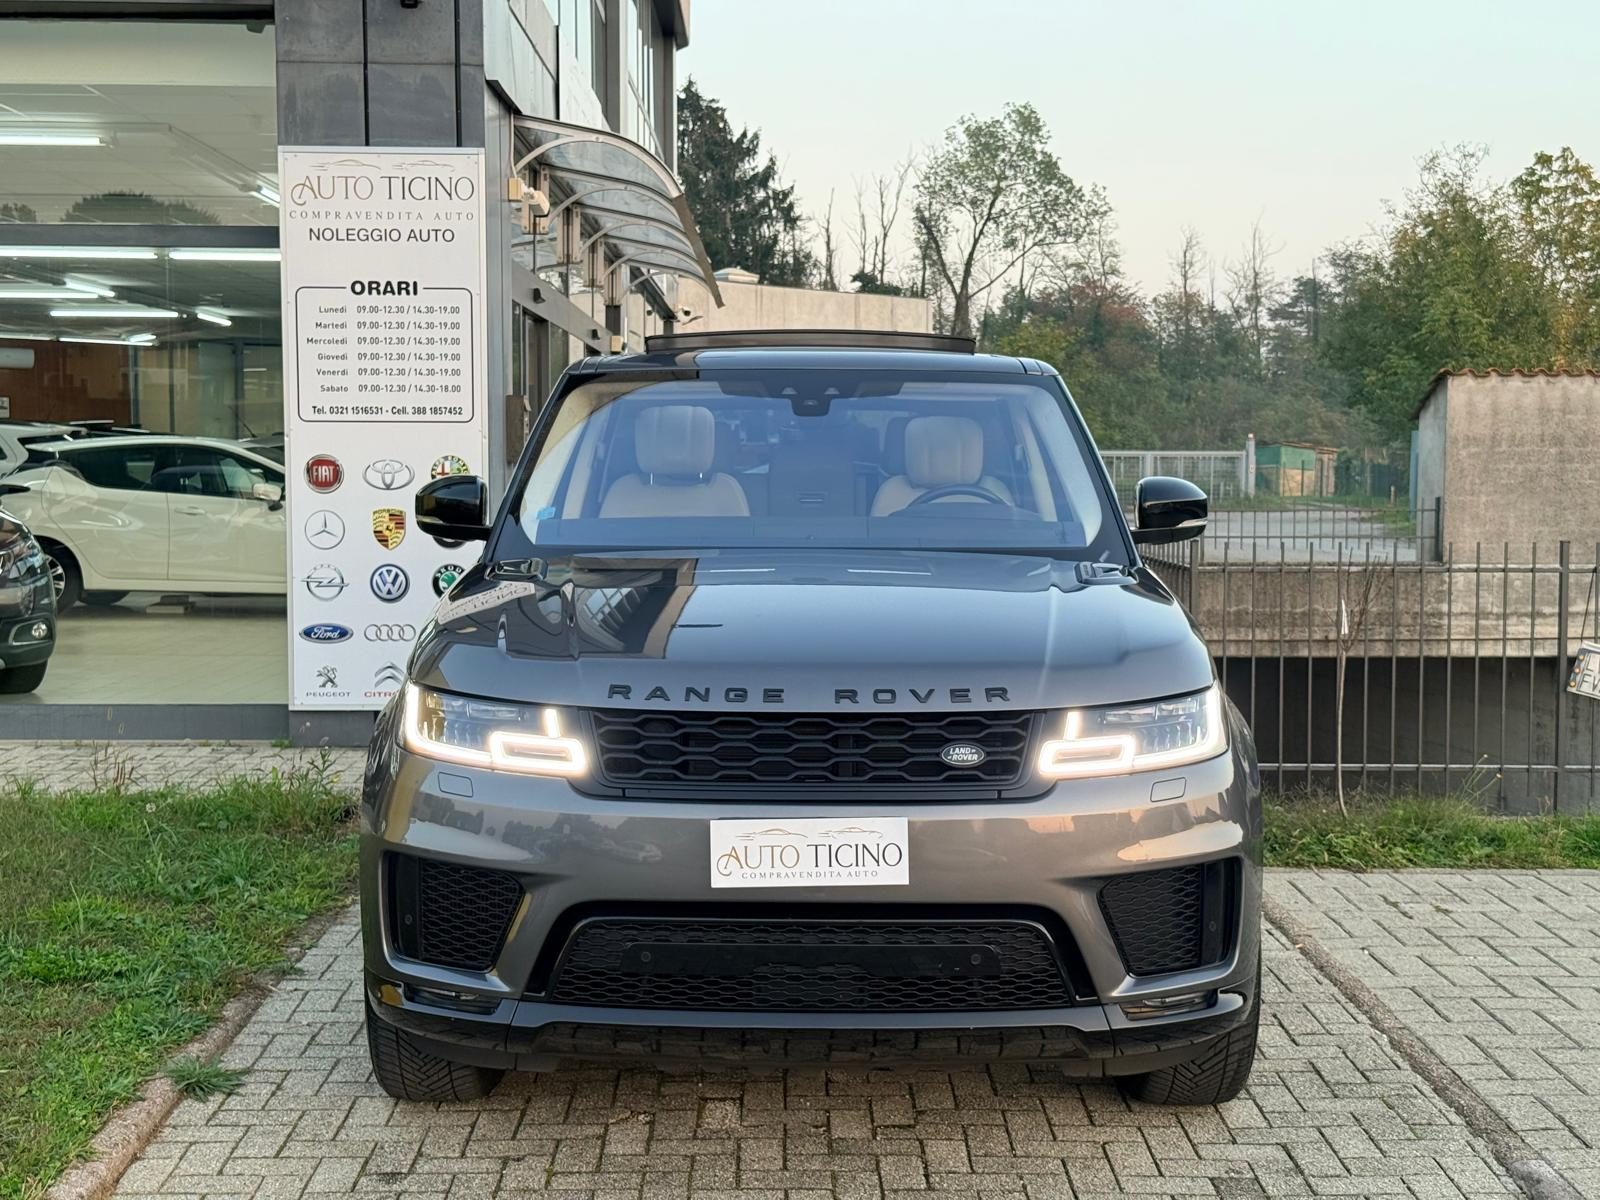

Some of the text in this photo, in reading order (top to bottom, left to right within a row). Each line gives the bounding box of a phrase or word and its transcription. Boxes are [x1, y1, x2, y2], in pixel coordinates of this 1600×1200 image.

[291, 175, 475, 206] AUTO TICINO
[289, 209, 475, 221] COMPRAVENDITA AUTO
[308, 227, 455, 243] NOLEGGIO AUTO
[350, 280, 418, 296] ORARI
[356, 305, 405, 314] 09.00-12.30
[412, 305, 460, 314] 14.30-19.00
[357, 321, 405, 330] 09.00-12.30
[413, 321, 460, 330] 14.30-19.00
[357, 336, 406, 345] 09.00-12.30
[413, 337, 461, 346] 14.30-19.00
[357, 352, 406, 361] 09.00-12.30
[413, 353, 461, 361] 14.30-19.00
[358, 367, 406, 376] 09.00-12.30
[414, 368, 461, 377] 14.30-19.00
[320, 384, 349, 393] Sabato
[358, 384, 406, 393] 09.00-12.30
[414, 384, 461, 393] 14.30-18.00
[312, 405, 327, 415] Tel.
[329, 405, 349, 415] 0321
[351, 406, 384, 415] 1516531
[391, 406, 409, 415] Cell.
[412, 406, 427, 415] 388
[429, 406, 463, 415] 1857452
[312, 465, 336, 483] FIAT
[311, 626, 341, 639] Ford
[607, 683, 1011, 704] RANGE ROVER
[949, 747, 971, 755] LAND
[716, 842, 903, 877] AUTO TICINO
[742, 869, 879, 880] COMPRAVENDITA AUTO
